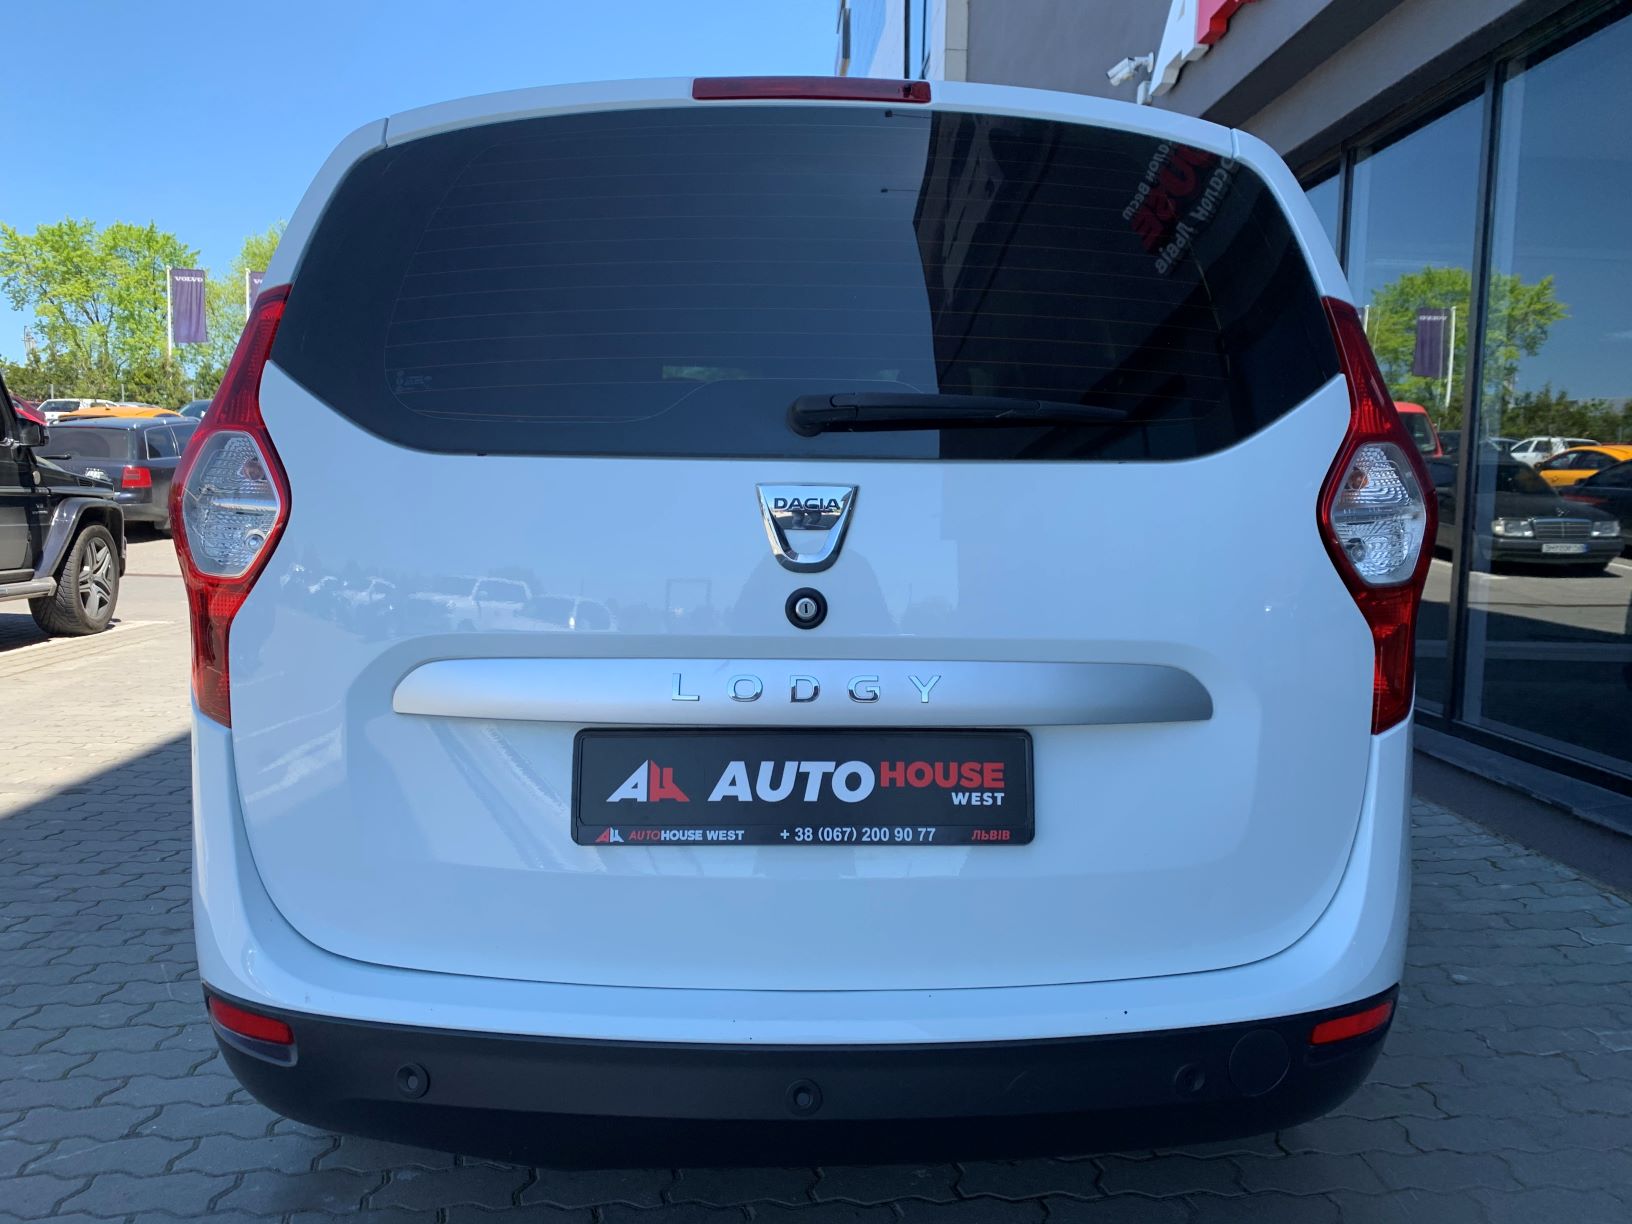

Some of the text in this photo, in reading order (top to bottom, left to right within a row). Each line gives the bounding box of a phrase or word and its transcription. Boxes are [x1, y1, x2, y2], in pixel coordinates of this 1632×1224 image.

[773, 497, 841, 511] DACIA
[671, 672, 942, 704] LODGY
[707, 760, 876, 803] AUTO
[879, 760, 1006, 789] HOUSE
[951, 791, 1006, 806] WEST
[706, 829, 745, 841] WEST
[794, 826, 814, 842] 38
[818, 826, 858, 843] (067)
[861, 827, 890, 842] 200
[894, 827, 913, 842] 90
[917, 827, 937, 842] 77
[971, 829, 1011, 842] ЛЬВІВ
